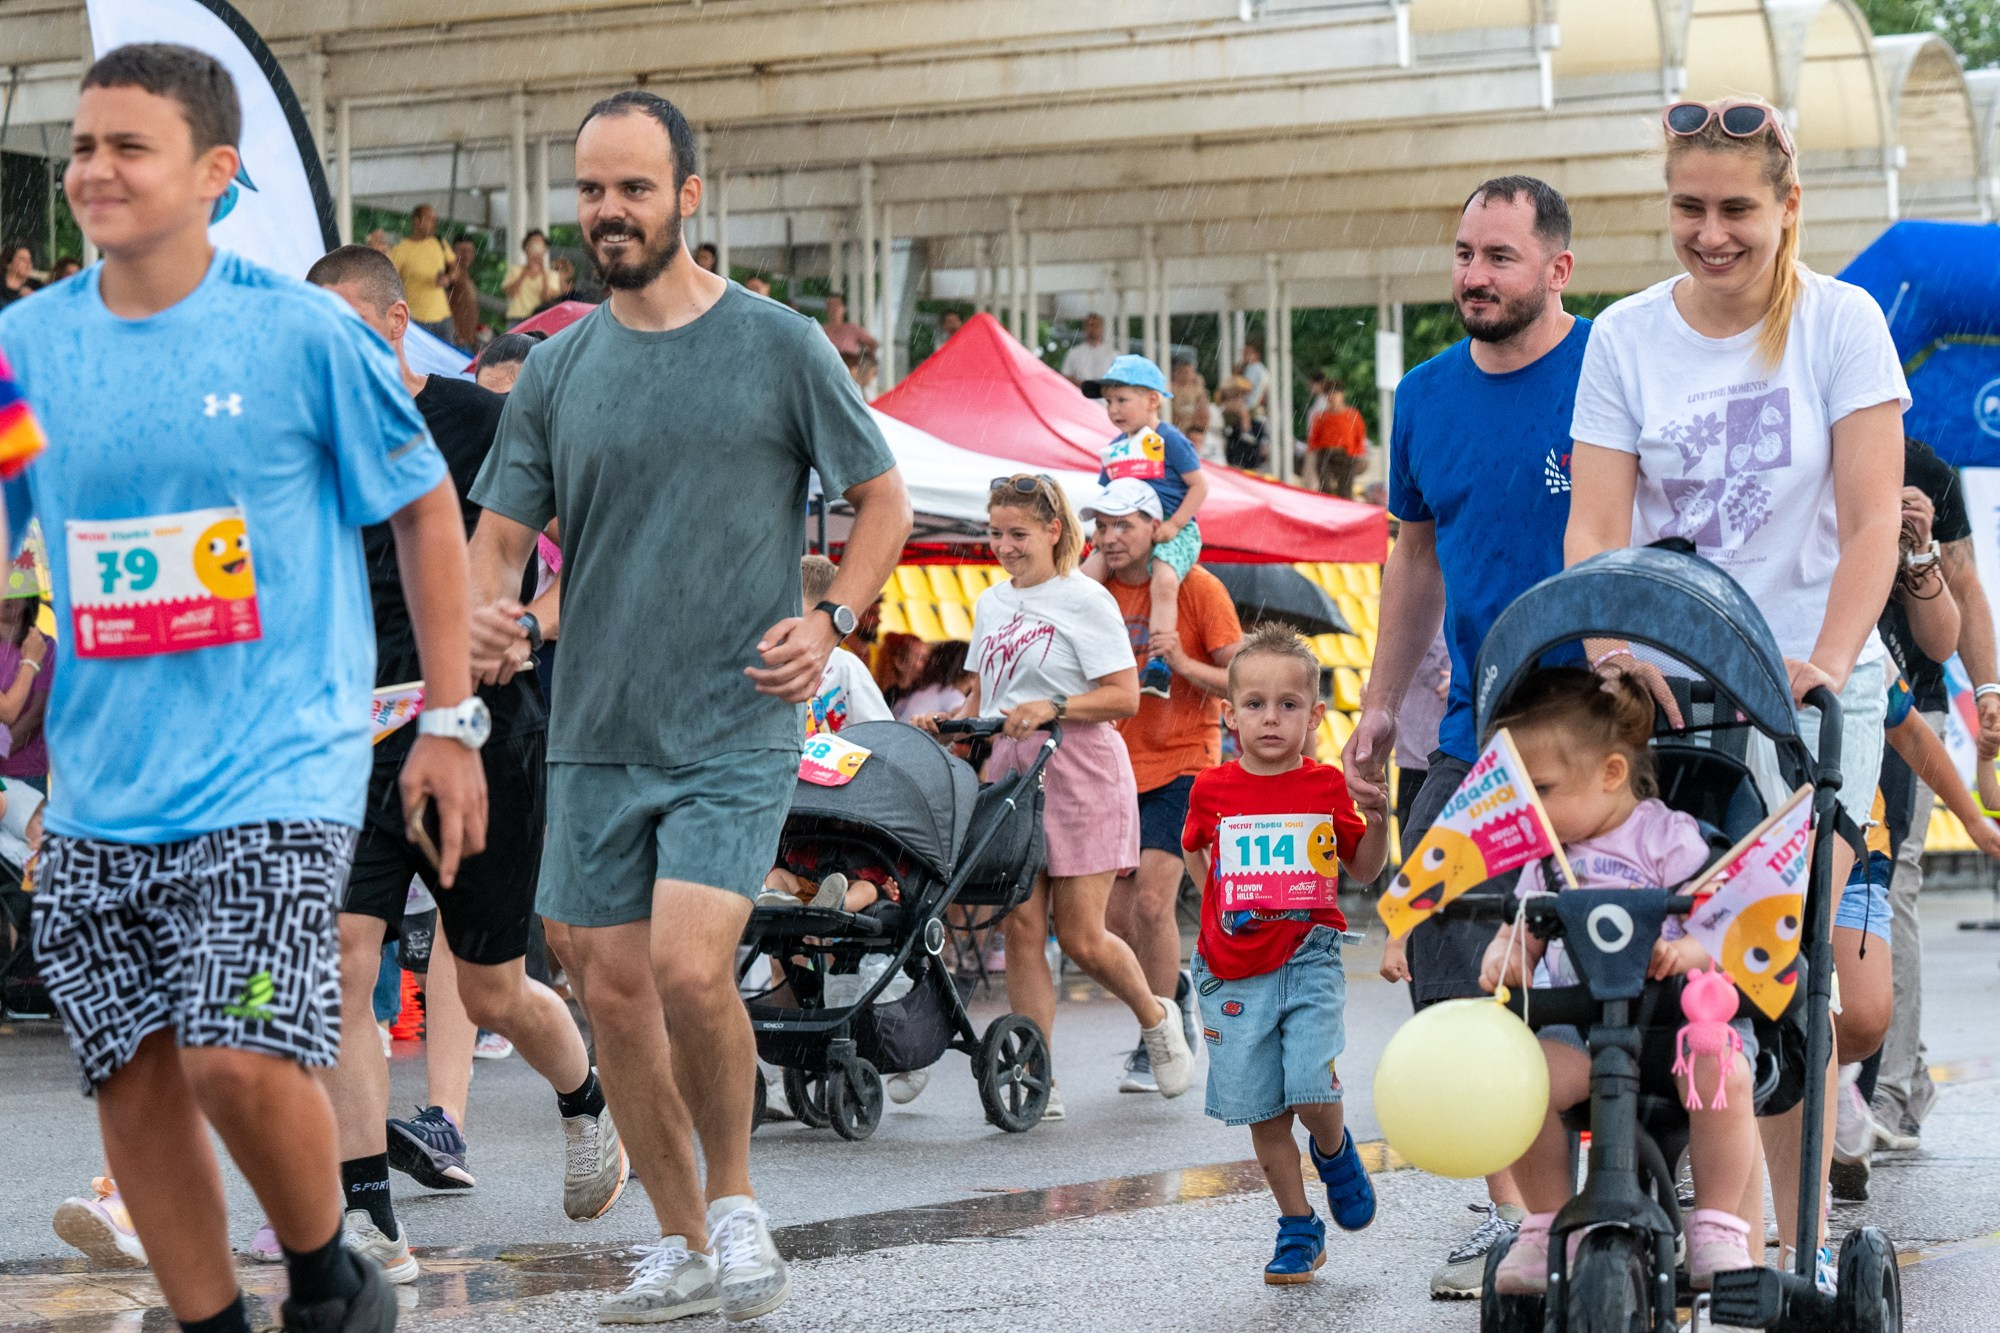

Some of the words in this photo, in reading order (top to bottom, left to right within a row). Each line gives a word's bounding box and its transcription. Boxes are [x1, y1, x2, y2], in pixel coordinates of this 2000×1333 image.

[1688, 391, 1707, 403] LIVE
[1708, 387, 1726, 399] THE
[1727, 380, 1769, 395] MOMENTS
[96, 547, 159, 593] 79
[985, 620, 1055, 700] Dancing
[1235, 834, 1295, 867] 114
[1236, 884, 1263, 893] PLOVDIV
[1236, 892, 1254, 900] HILLS
[351, 1180, 390, 1193] SPORT
